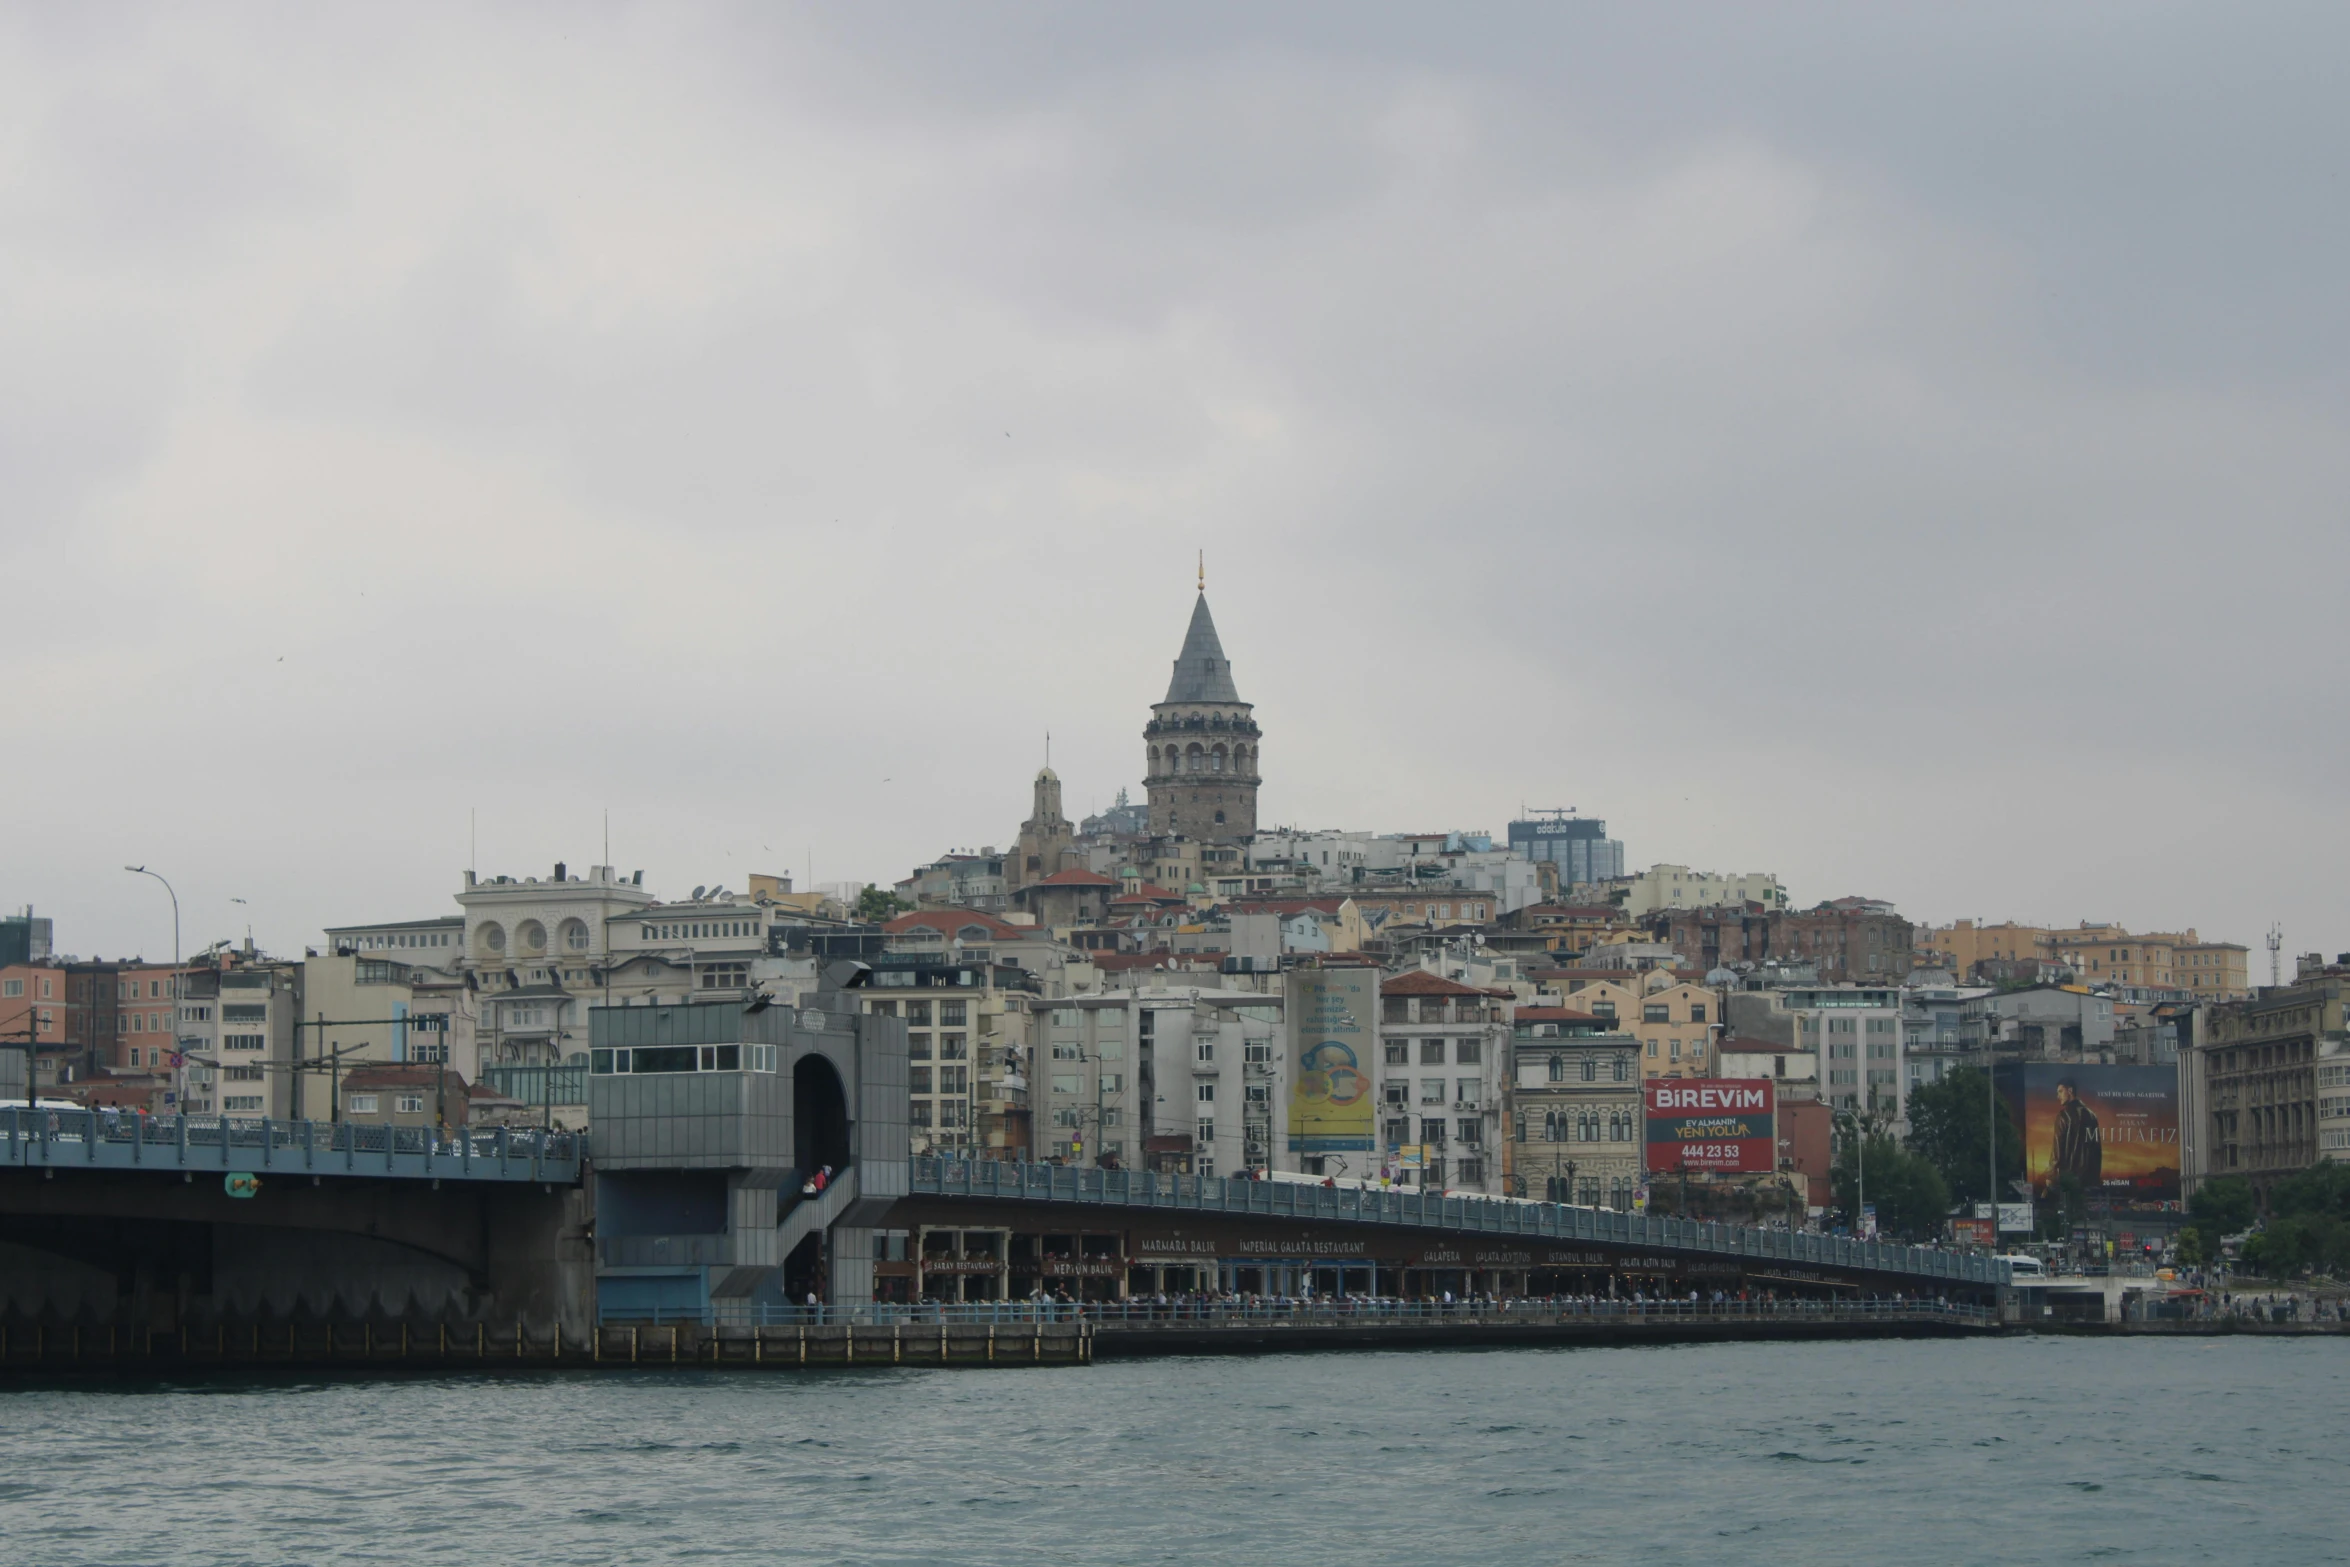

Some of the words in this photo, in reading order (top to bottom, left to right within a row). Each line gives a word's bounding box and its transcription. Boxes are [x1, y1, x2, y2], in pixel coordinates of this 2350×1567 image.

[1536, 821, 1567, 834] odakule
[1315, 995, 1330, 1003] her
[1331, 997, 1345, 1005] şey
[1301, 1025, 1331, 1034] elinizin
[1332, 1025, 1361, 1033] altında
[1685, 1119, 1698, 1127] EV
[1698, 1117, 1737, 1127] ALMANIN
[1675, 1126, 1705, 1139] YENİ
[1705, 1125, 1744, 1138] YOLU
[1681, 1144, 1704, 1157] 444
[1706, 1144, 1722, 1158] 23
[1724, 1144, 1740, 1158] 53
[1683, 1158, 1740, 1167] www.birevim.com
[2102, 1179, 2111, 1187] 26
[2111, 1177, 2130, 1187] NİSAN
[1141, 1239, 1187, 1252] MARMARA
[1190, 1240, 1216, 1252] BALIK
[1280, 1241, 1312, 1253] GALATA
[1423, 1251, 1461, 1262] GALAPERA
[1475, 1251, 1500, 1263] GALATA
[1548, 1249, 1581, 1263] İSTANBUL
[1584, 1252, 1604, 1263] BALIK
[933, 1261, 954, 1271] SARAY
[956, 1260, 994, 1271] RESTAURANT
[1619, 1257, 1640, 1268] GALATA
[1642, 1258, 1660, 1268] ALTIN
[1660, 1258, 1677, 1269] BALIK
[1090, 1264, 1113, 1275] BALIK
